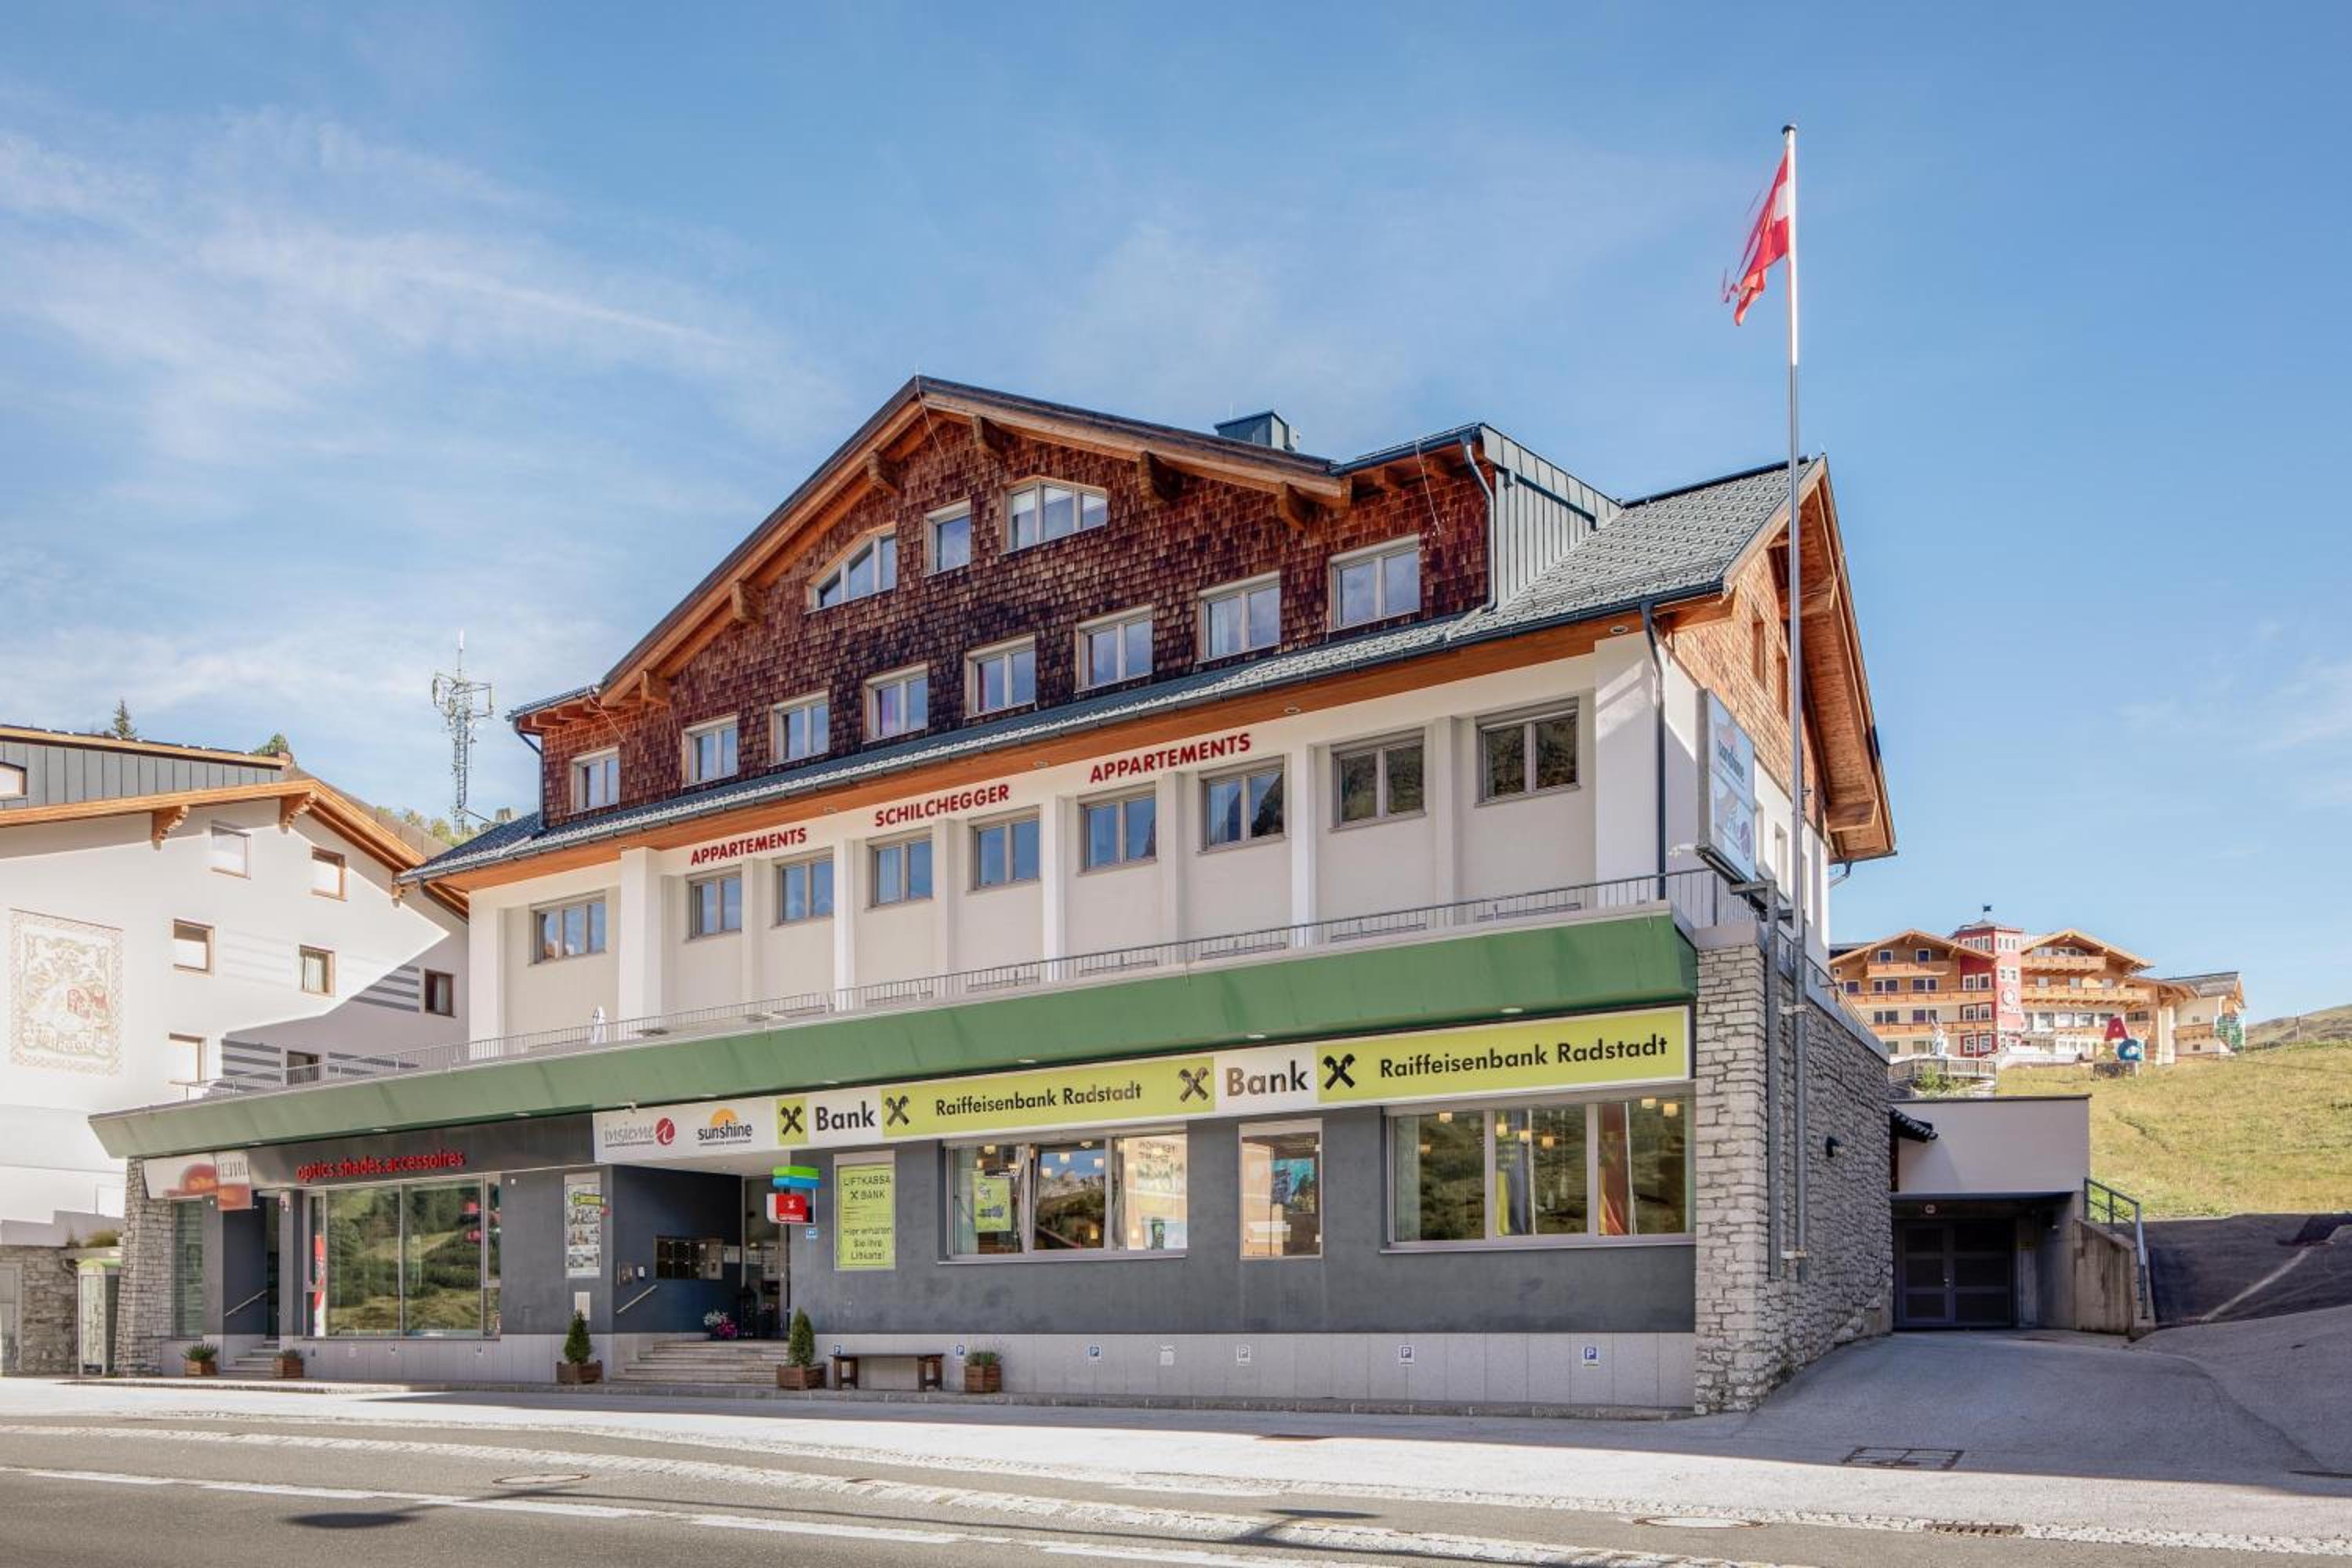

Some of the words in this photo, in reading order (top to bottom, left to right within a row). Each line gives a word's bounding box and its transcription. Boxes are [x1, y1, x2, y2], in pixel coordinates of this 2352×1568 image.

[1090, 732, 1251, 784] APPARTEMENTS
[875, 783, 1010, 828] SCHILCHEGGER
[690, 826, 808, 866] APPARTEMENTS
[1380, 1044, 1548, 1079] Raiffeisenbank
[1557, 1033, 1668, 1064] Radstadt
[1226, 1060, 1308, 1098] Bank
[815, 1101, 876, 1132] Bank
[935, 1090, 1057, 1117] Raiffeisenbank
[1063, 1081, 1142, 1105] Radstadt
[697, 1119, 753, 1141] sunshine
